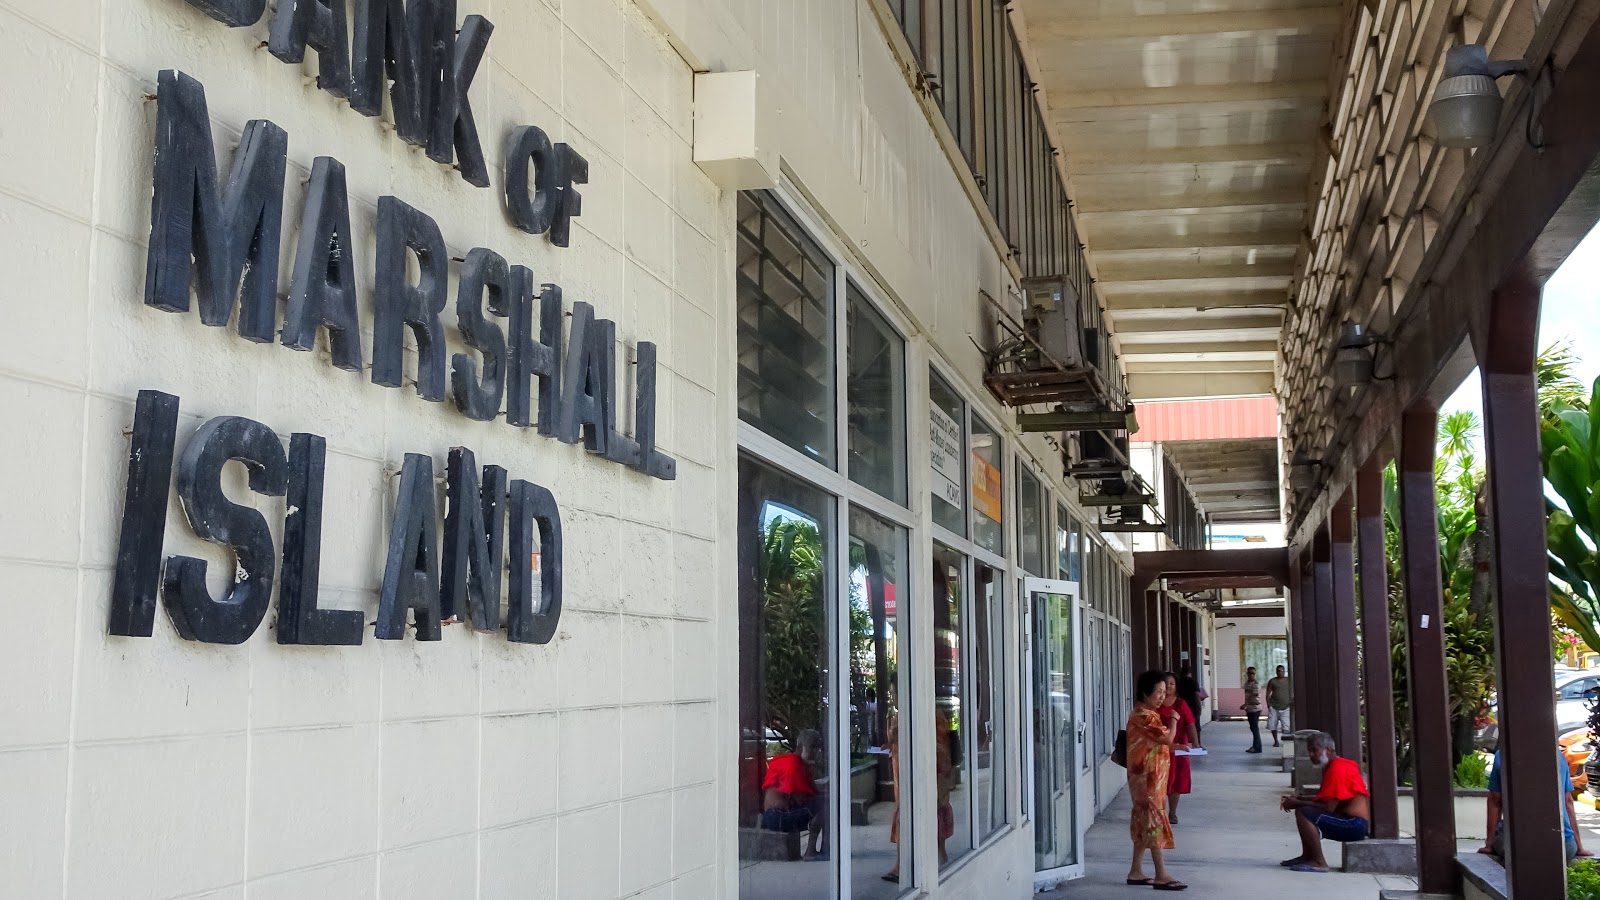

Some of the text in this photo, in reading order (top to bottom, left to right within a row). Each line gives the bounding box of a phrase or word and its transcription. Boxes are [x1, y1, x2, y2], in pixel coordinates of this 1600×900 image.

[186, 0, 589, 248] ANK OF
[144, 68, 676, 481] MARSHALL
[109, 389, 563, 646] ISLAND
